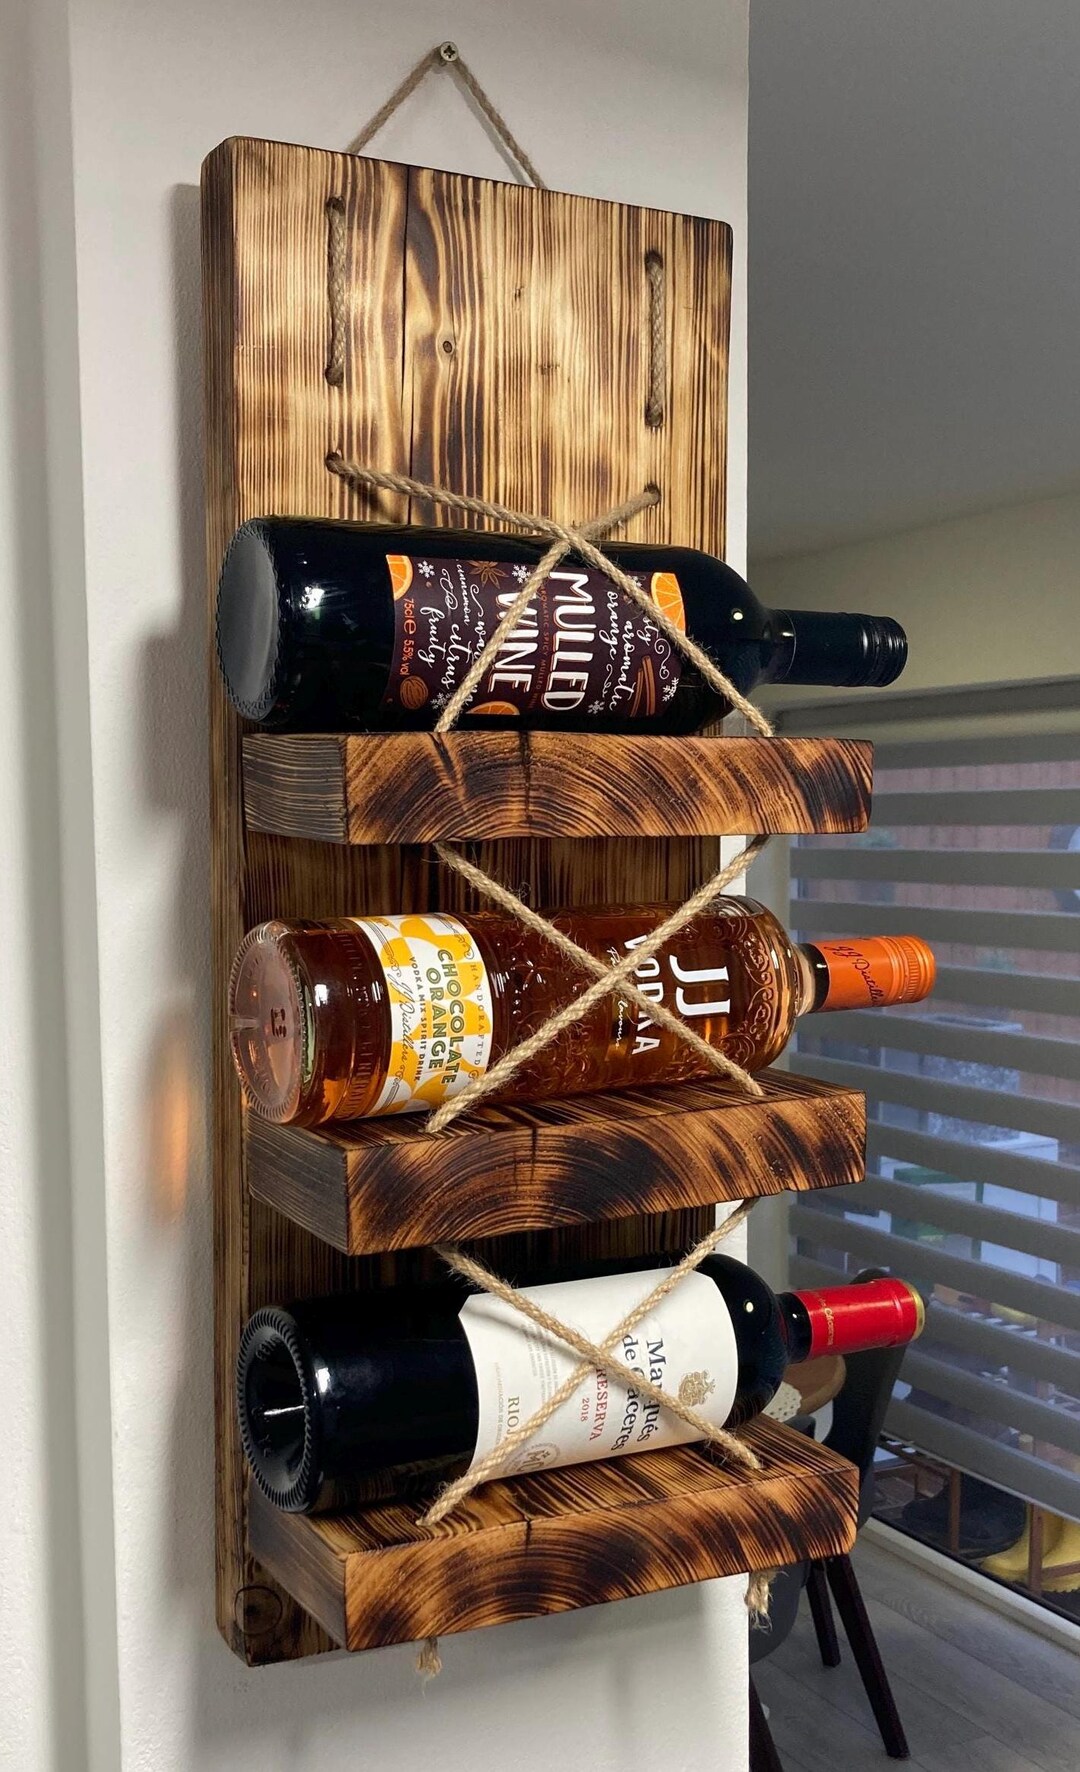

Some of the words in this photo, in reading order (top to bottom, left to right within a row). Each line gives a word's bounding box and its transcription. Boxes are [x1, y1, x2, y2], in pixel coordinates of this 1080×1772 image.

[457, 565, 471, 626] cinnamon
[599, 591, 620, 661] orange
[418, 607, 447, 668] fruity
[441, 624, 472, 689] citrus
[489, 592, 539, 693] WINE
[541, 571, 597, 711] MULLED
[542, 631, 550, 656] SPICY
[610, 620, 636, 711] aromatic
[400, 662, 411, 676] vol
[409, 956, 424, 991] VODKA
[669, 955, 731, 1016] JJ
[852, 959, 884, 1006] Distille
[399, 999, 416, 1063] Distillers
[426, 967, 447, 1069] ORANGE
[438, 949, 464, 1083] CHOCOLATE
[470, 965, 486, 1066] HANDCRAFTED
[414, 1053, 426, 1082] DRINK
[622, 1335, 639, 1361] de
[506, 1397, 520, 1435] RIOJ
[581, 1397, 590, 1422] 2018
[590, 1368, 608, 1441] RESERVA
